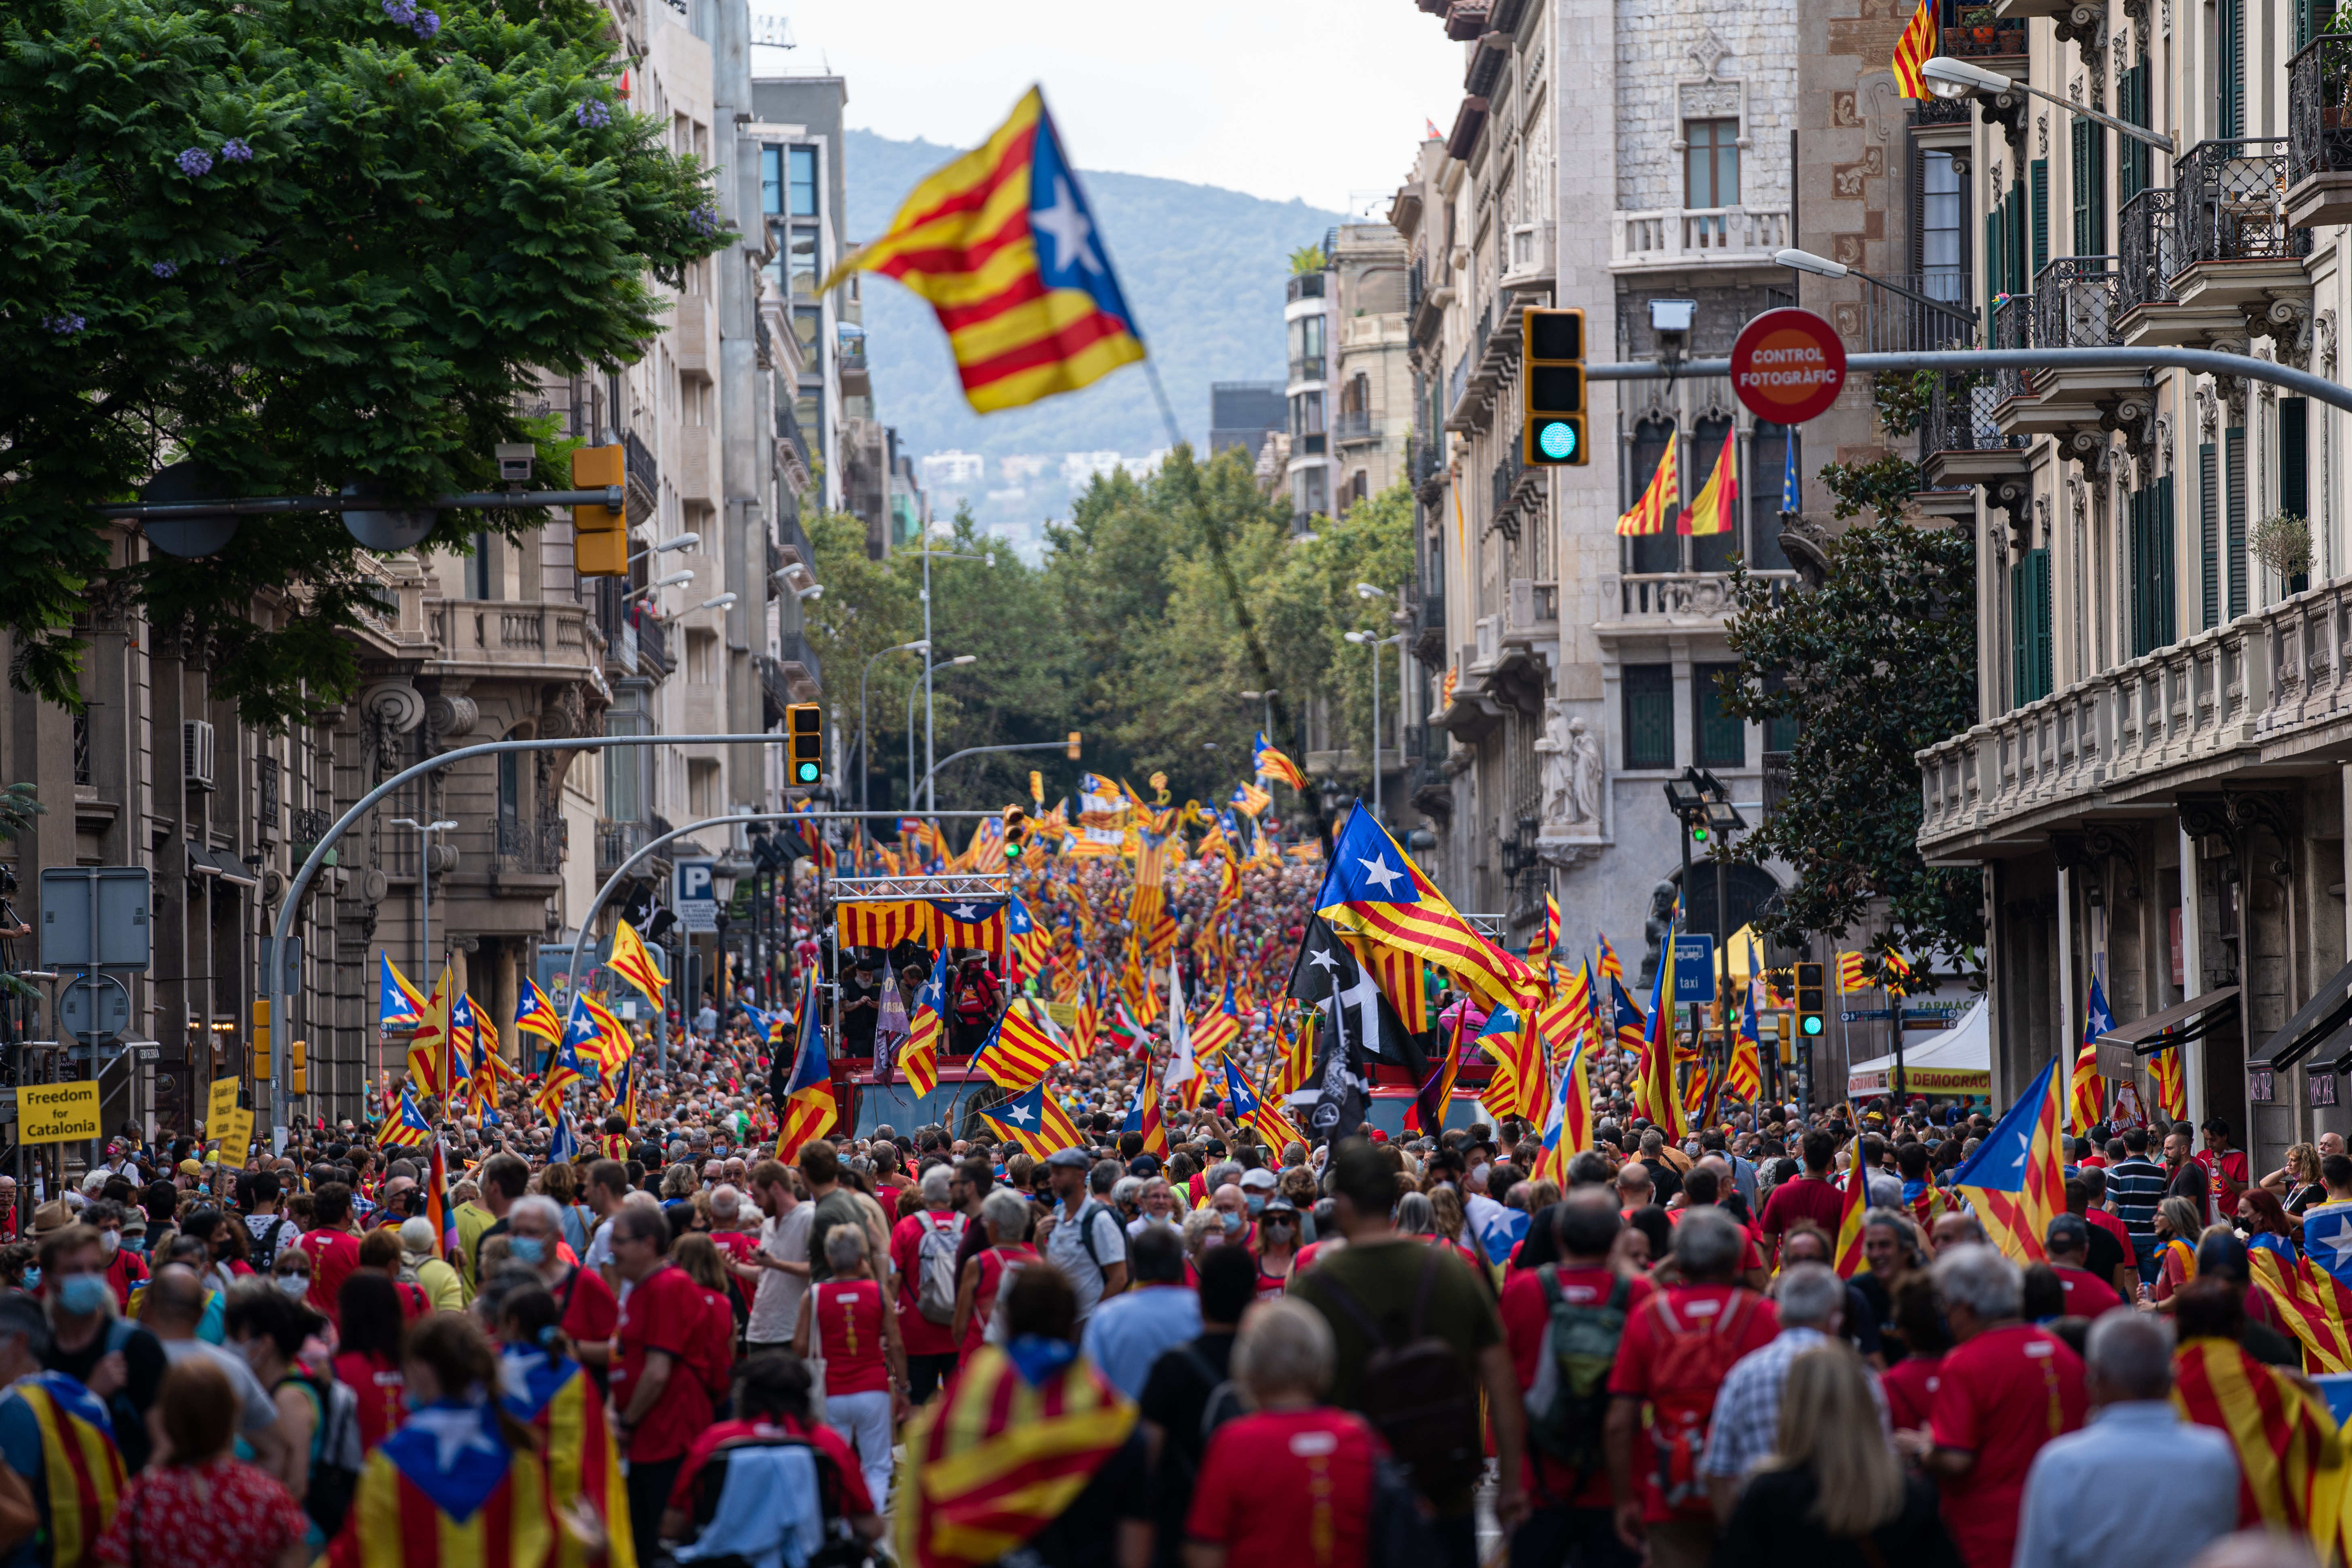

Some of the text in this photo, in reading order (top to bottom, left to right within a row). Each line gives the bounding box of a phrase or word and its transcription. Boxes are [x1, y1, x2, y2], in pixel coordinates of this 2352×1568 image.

[1751, 347, 1825, 364] CONTROL
[1740, 366, 1837, 387] FOTOGRÀFIC
[686, 866, 711, 897] P
[1680, 976, 1698, 989] taxi
[1918, 998, 1974, 1010] FARMÀCI
[27, 1089, 92, 1105] Freedom
[53, 1109, 68, 1118] for
[27, 1119, 95, 1137] Catalonia
